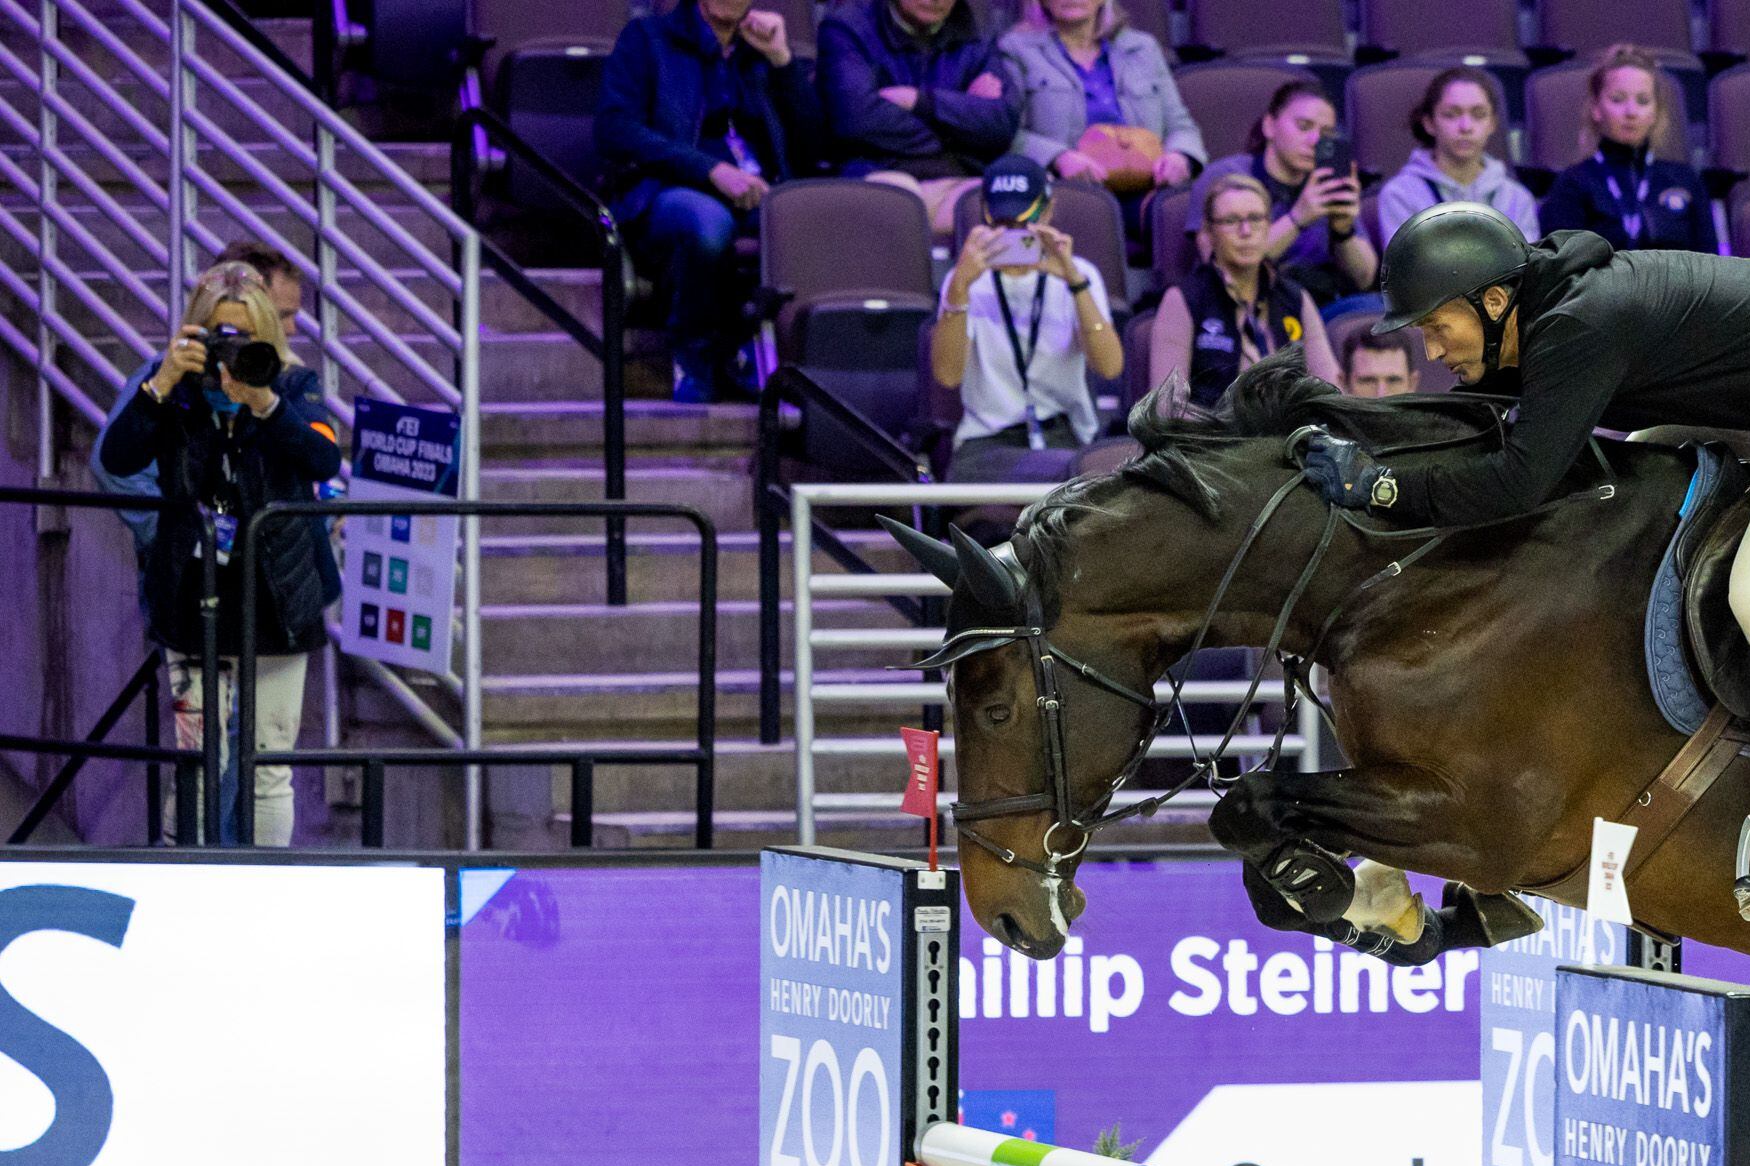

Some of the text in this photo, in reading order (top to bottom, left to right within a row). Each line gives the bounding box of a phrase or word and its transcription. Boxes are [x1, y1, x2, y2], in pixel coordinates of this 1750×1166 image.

[991, 175, 1028, 192] AUS
[360, 429, 395, 452] WORLD
[396, 436, 417, 457] CUP
[770, 885, 892, 974] OMAHA'S
[1168, 935, 1479, 1016] Steiner
[1492, 971, 1544, 1011] HENRY
[770, 977, 891, 1030] HENRY DOORLY
[1565, 1009, 1712, 1118] OMAHA'S
[1565, 1118, 1628, 1166] HENRY
